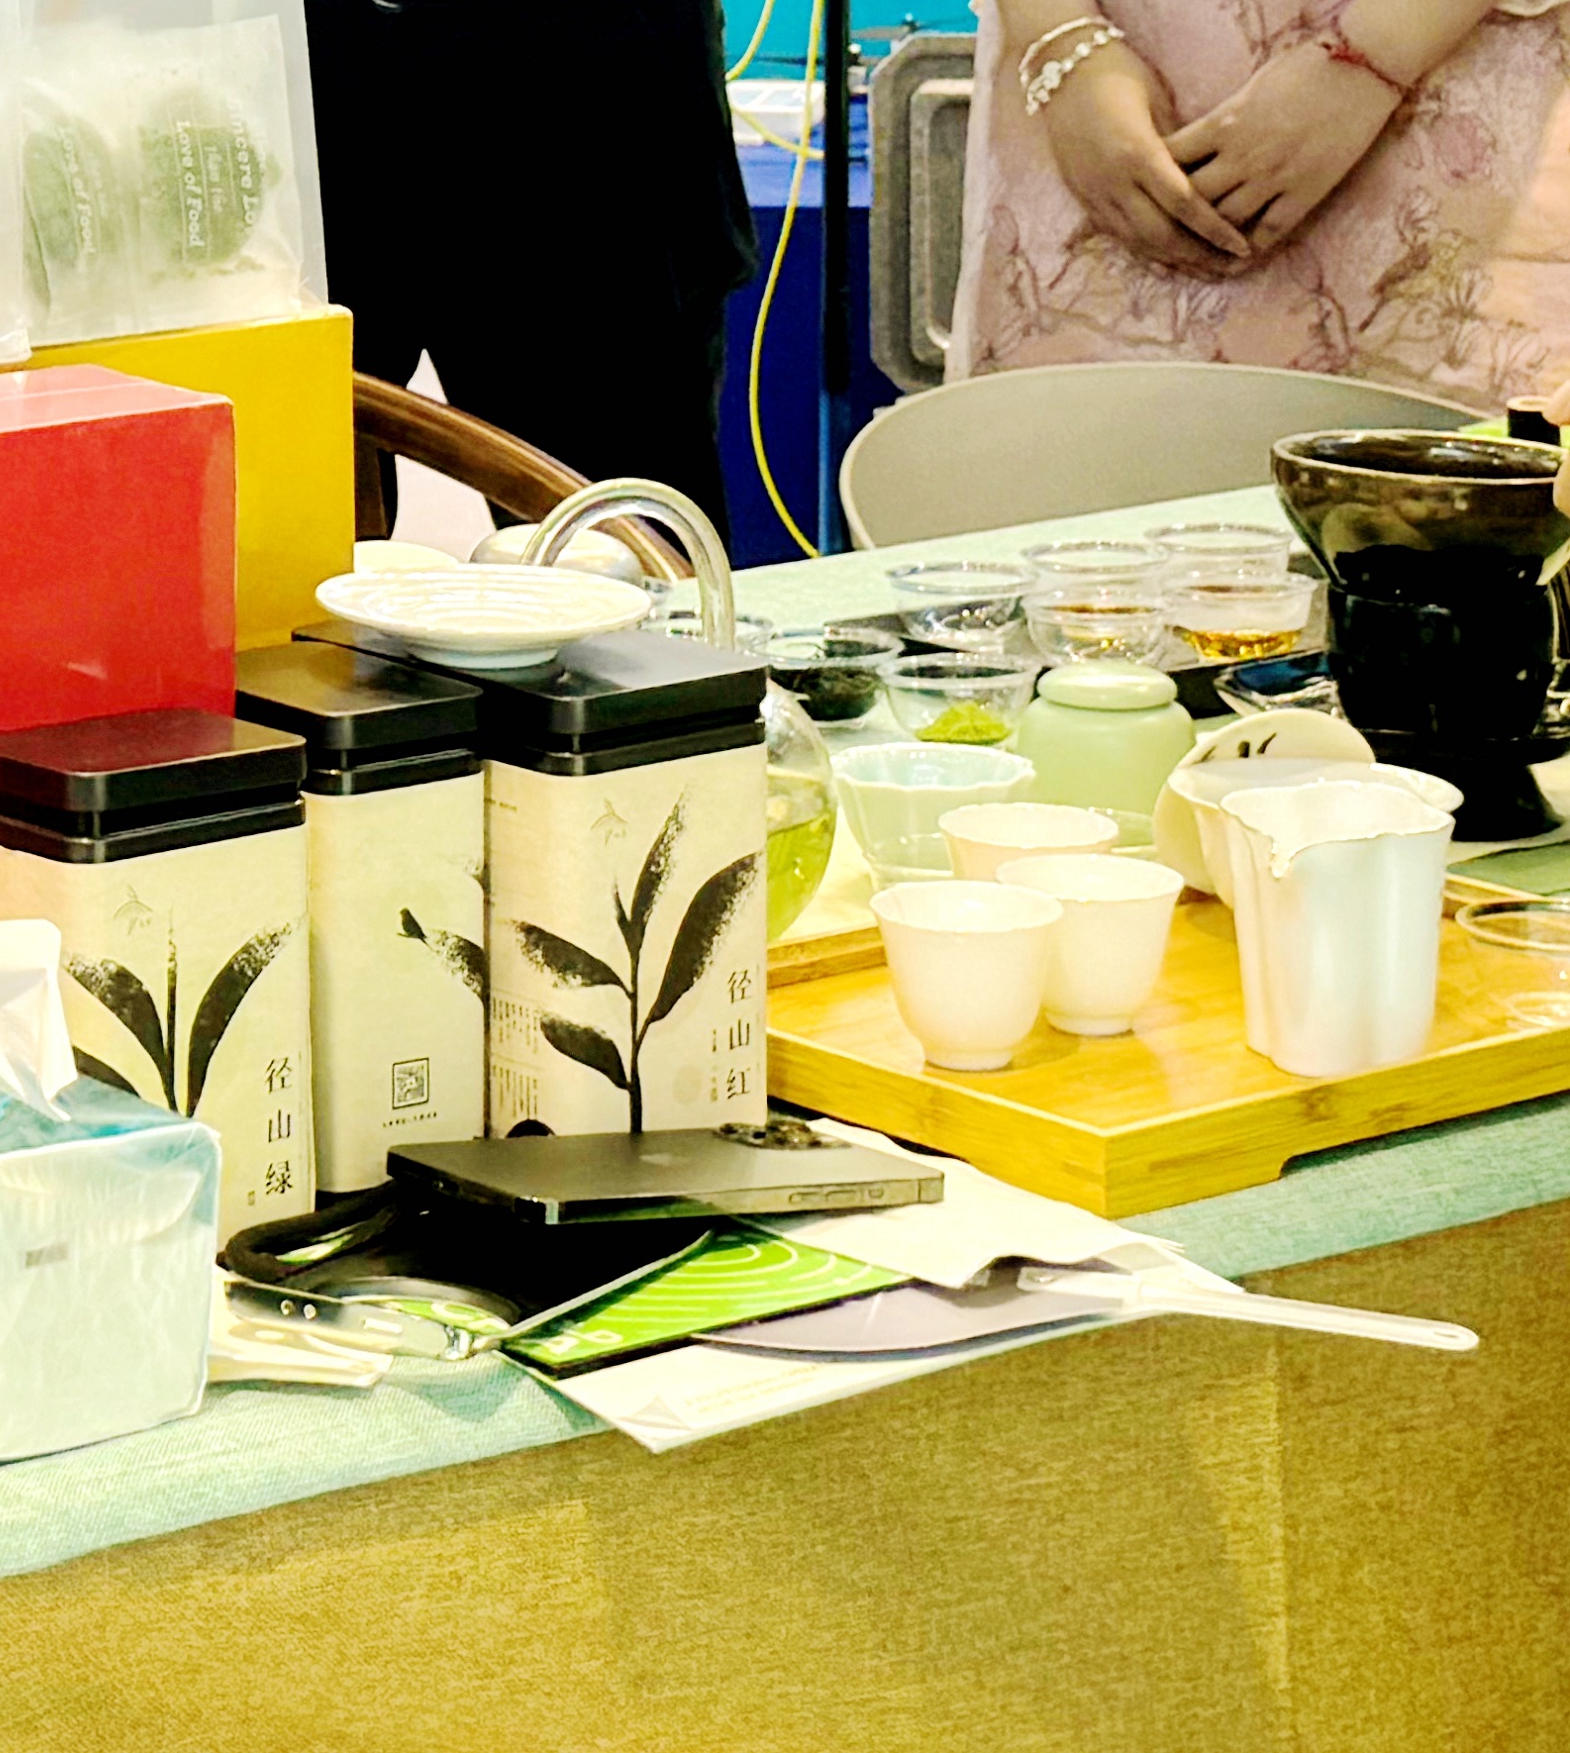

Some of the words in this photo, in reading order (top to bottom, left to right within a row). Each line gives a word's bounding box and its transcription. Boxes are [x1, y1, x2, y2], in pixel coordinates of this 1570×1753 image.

[176, 121, 194, 169] Love
[184, 172, 203, 194] of
[186, 197, 206, 247] Food
[725, 967, 754, 1100] 径山红
[264, 1056, 294, 1196] 径山绿
